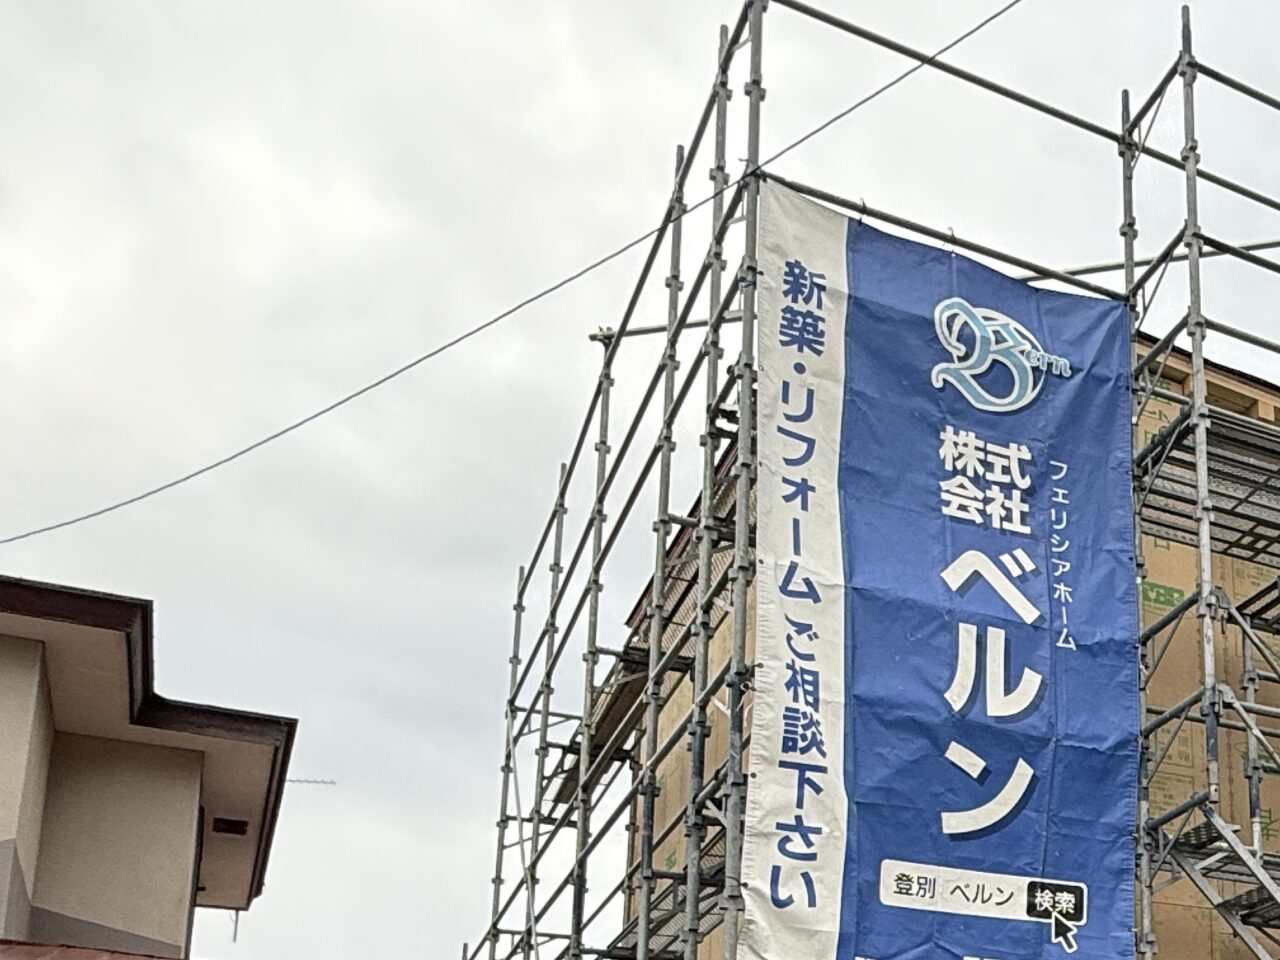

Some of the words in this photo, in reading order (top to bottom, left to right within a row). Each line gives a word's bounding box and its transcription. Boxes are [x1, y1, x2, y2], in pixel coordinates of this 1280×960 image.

[1048, 460, 1078, 651] フェリシアホーム
[893, 872, 937, 899] 登別
[950, 883, 1015, 906] ベルン
[1034, 888, 1077, 914] 検索
